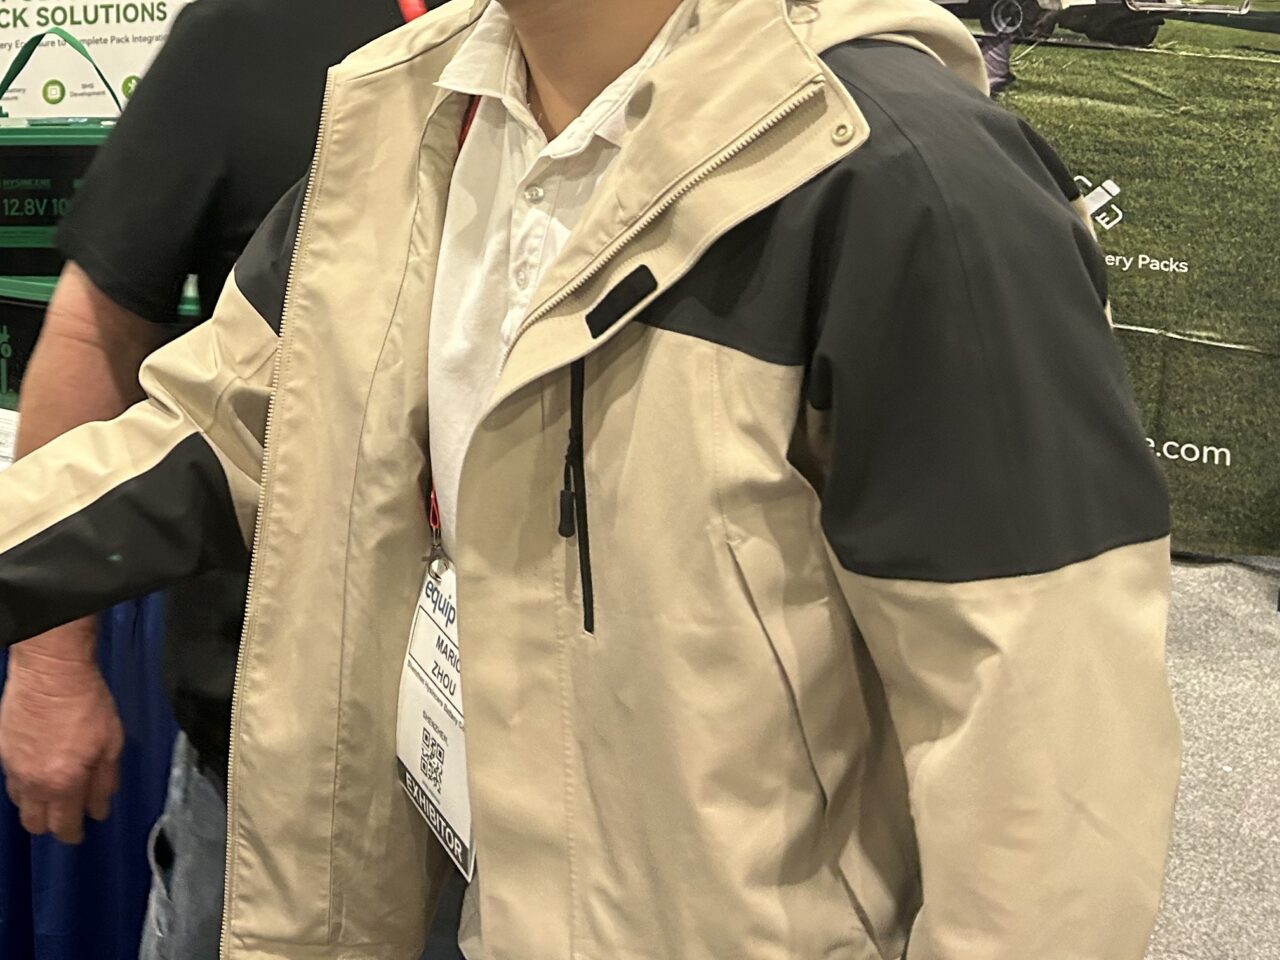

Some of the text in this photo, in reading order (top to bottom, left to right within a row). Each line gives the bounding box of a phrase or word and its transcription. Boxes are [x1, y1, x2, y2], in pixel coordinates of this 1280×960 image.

[36, 1, 168, 28] SOLUTIONS
[111, 34, 130, 44] Pack
[2, 198, 48, 216] 12.8V
[1138, 254, 1189, 273] Packs
[424, 579, 457, 628] equip
[431, 660, 457, 697] ZHOU
[405, 771, 464, 863] EXHIBITOR
